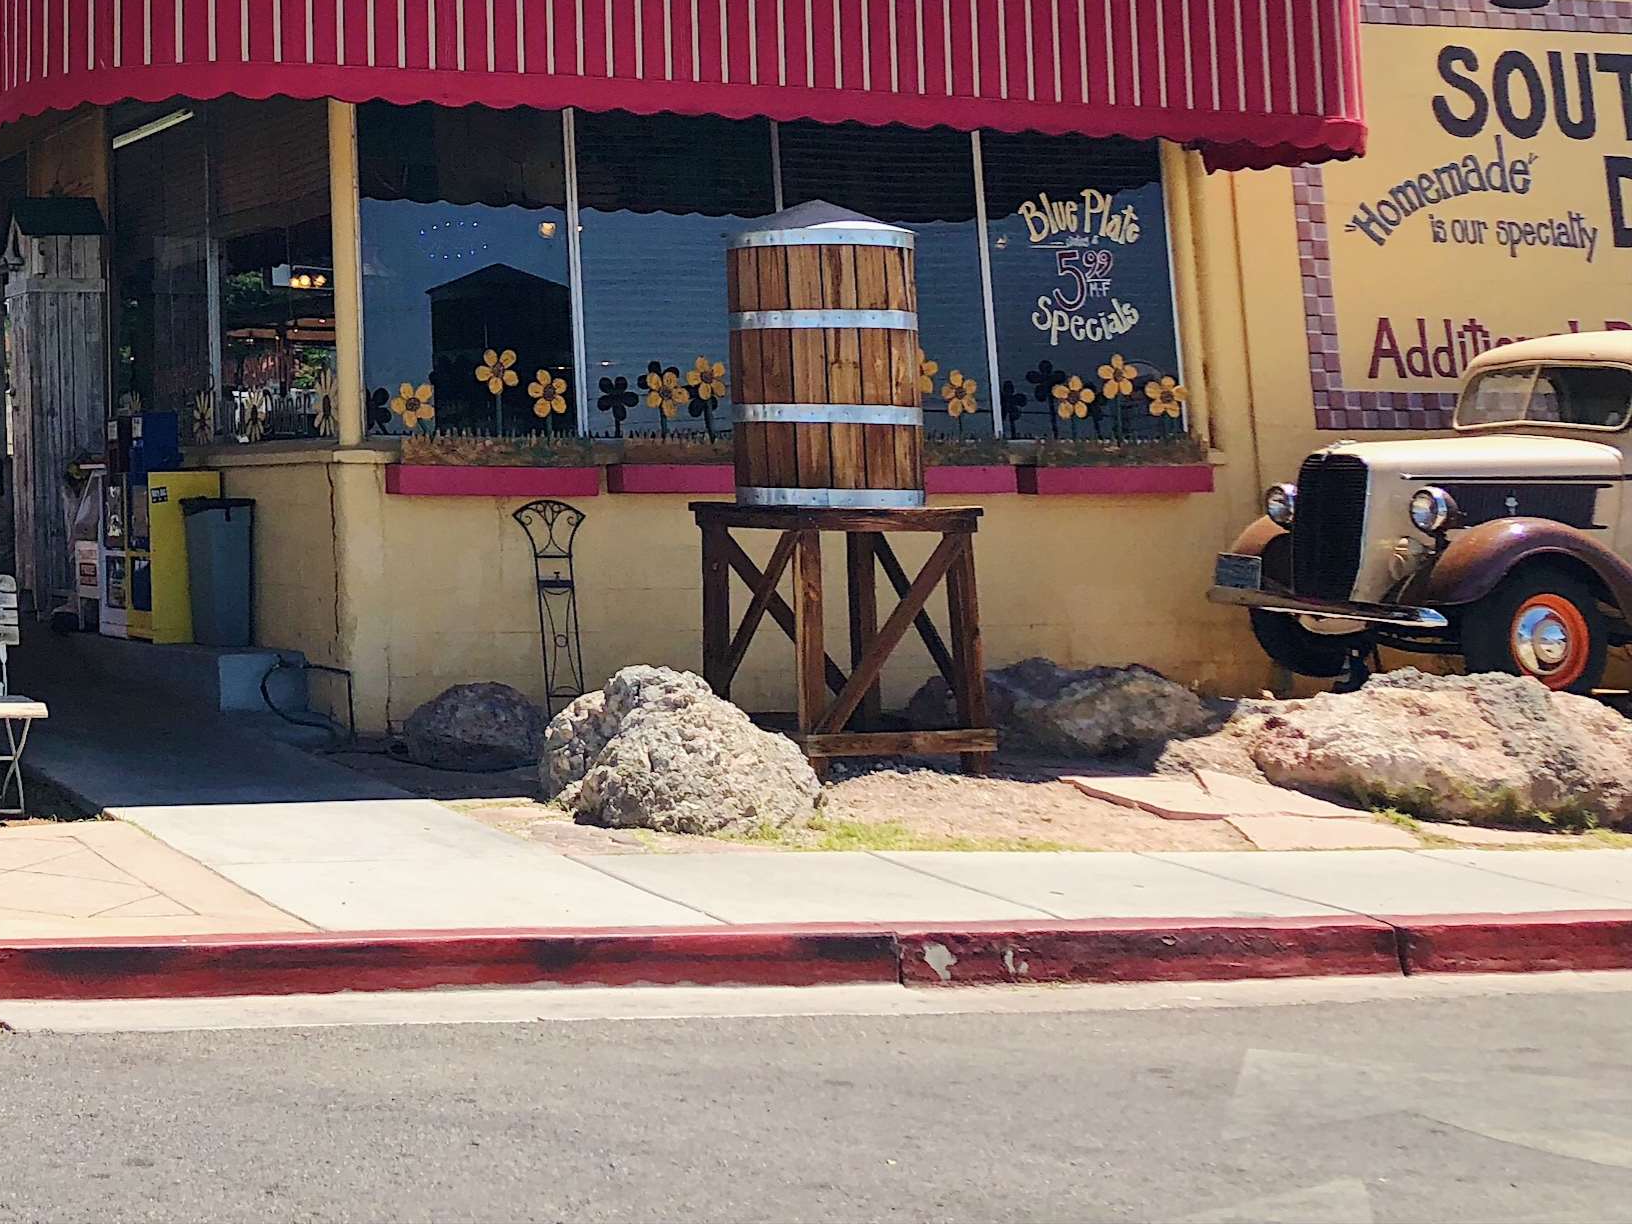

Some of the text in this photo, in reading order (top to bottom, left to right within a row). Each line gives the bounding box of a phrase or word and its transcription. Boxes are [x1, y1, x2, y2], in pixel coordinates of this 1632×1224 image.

[1018, 188, 1141, 244] Blue Plate
[1428, 211, 1599, 263] is our specialty
[1032, 295, 1140, 346] Specials
[1368, 317, 1579, 379] Addit
